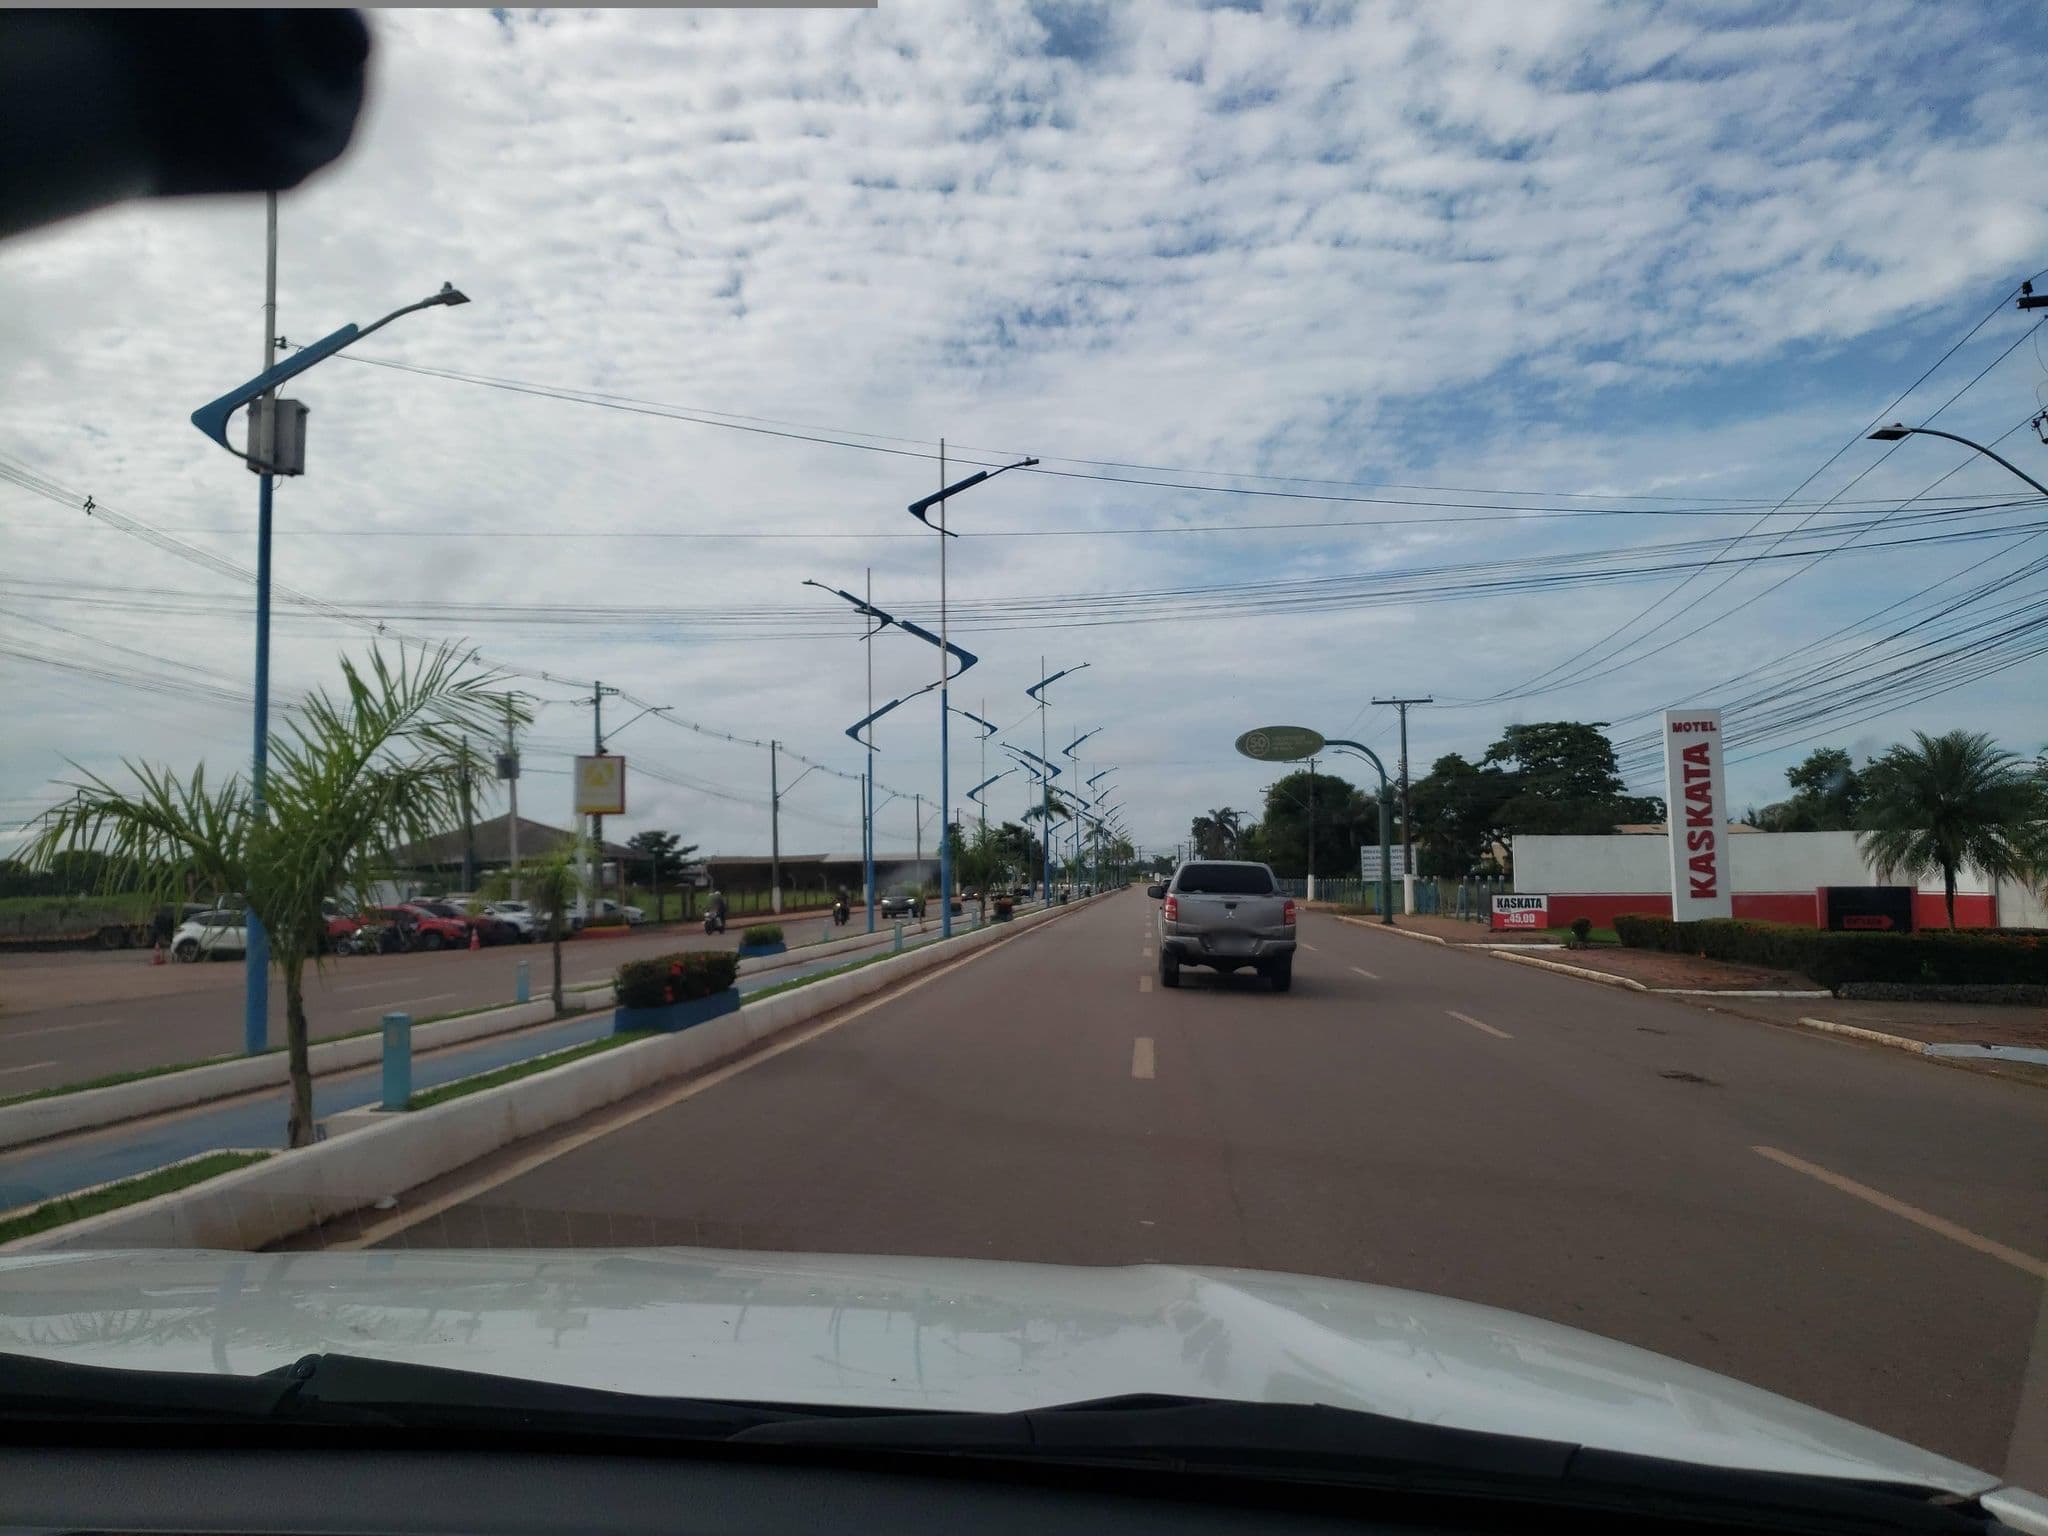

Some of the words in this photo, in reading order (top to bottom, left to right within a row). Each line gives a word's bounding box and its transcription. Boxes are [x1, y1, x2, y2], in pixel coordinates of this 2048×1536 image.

[1672, 721, 1717, 733] MOTEL
[1683, 741, 1717, 899] KASKATA
[1496, 898, 1542, 908] KASKATA
